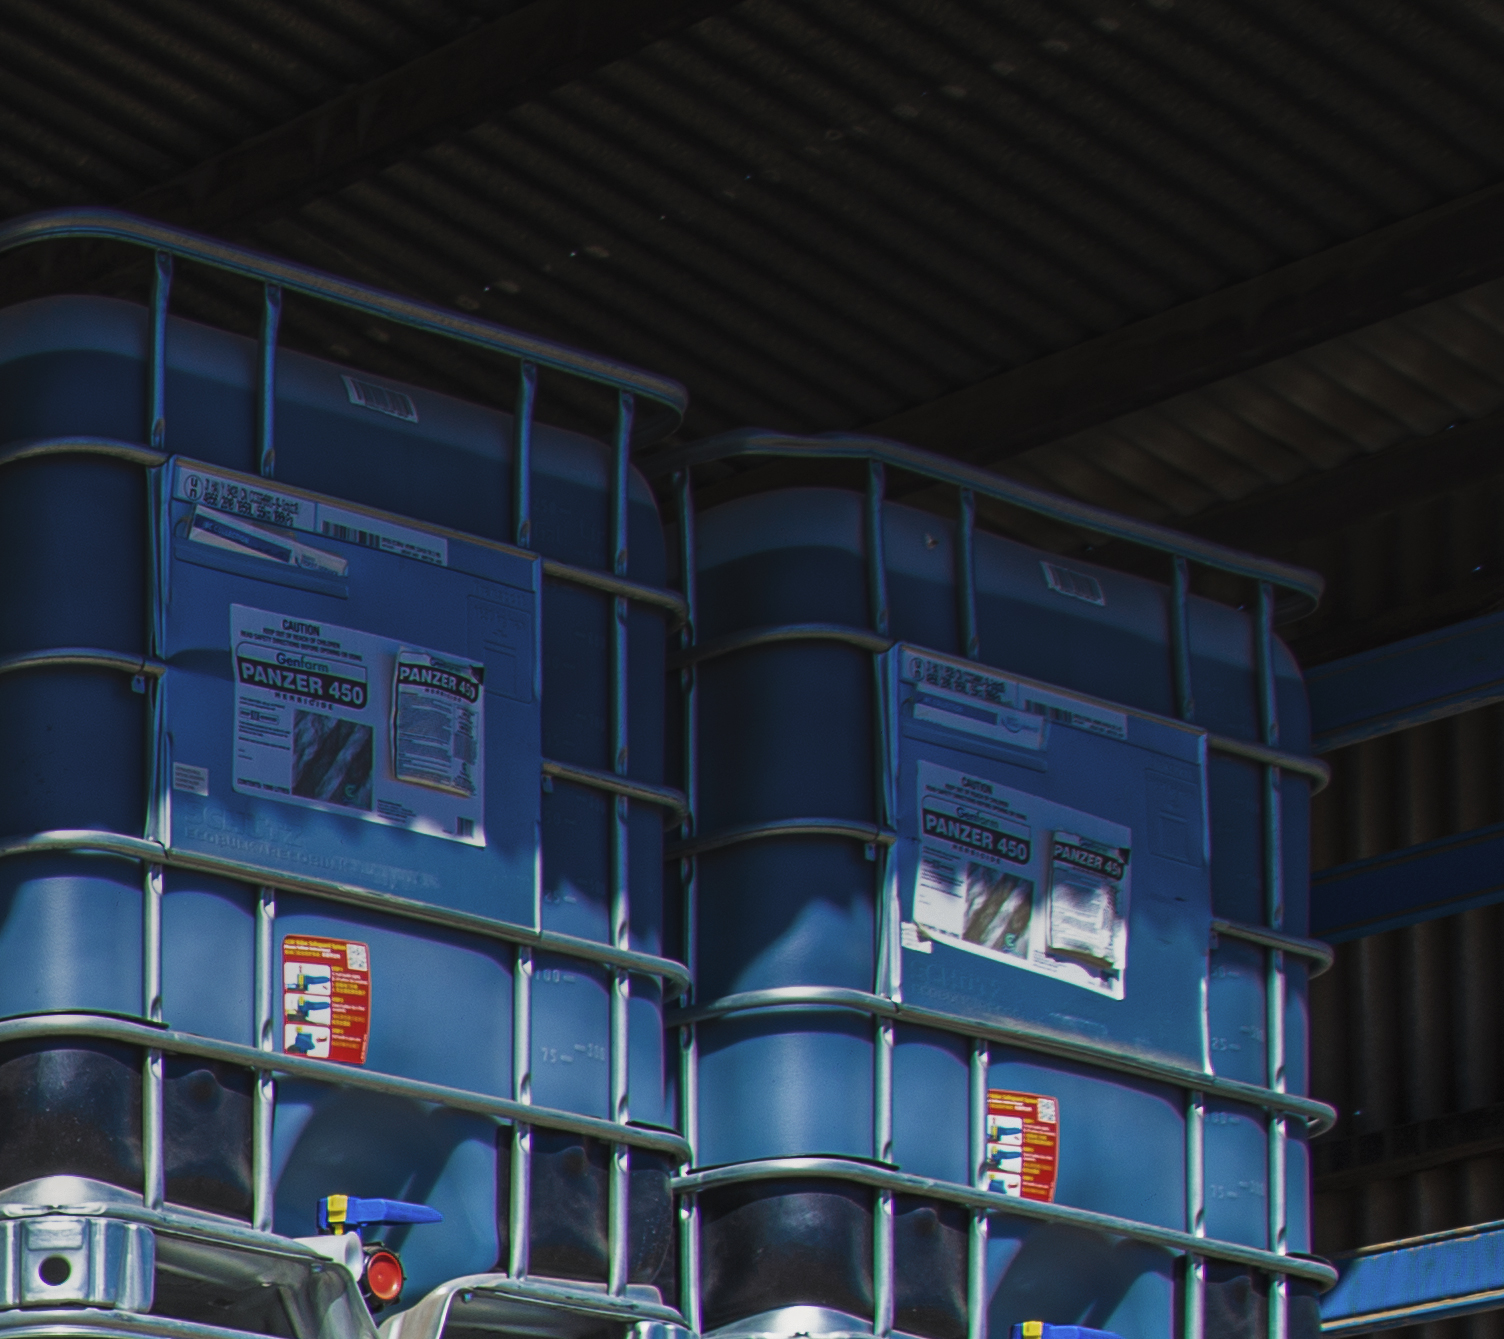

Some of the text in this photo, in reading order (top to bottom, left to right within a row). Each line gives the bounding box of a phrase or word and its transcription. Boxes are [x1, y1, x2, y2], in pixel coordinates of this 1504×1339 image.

[282, 618, 320, 637] CAUTION
[276, 651, 328, 673] Genfarm
[241, 662, 364, 705] PANZER 450
[400, 665, 457, 691] PANZER
[925, 813, 1028, 861] PANZER 450
